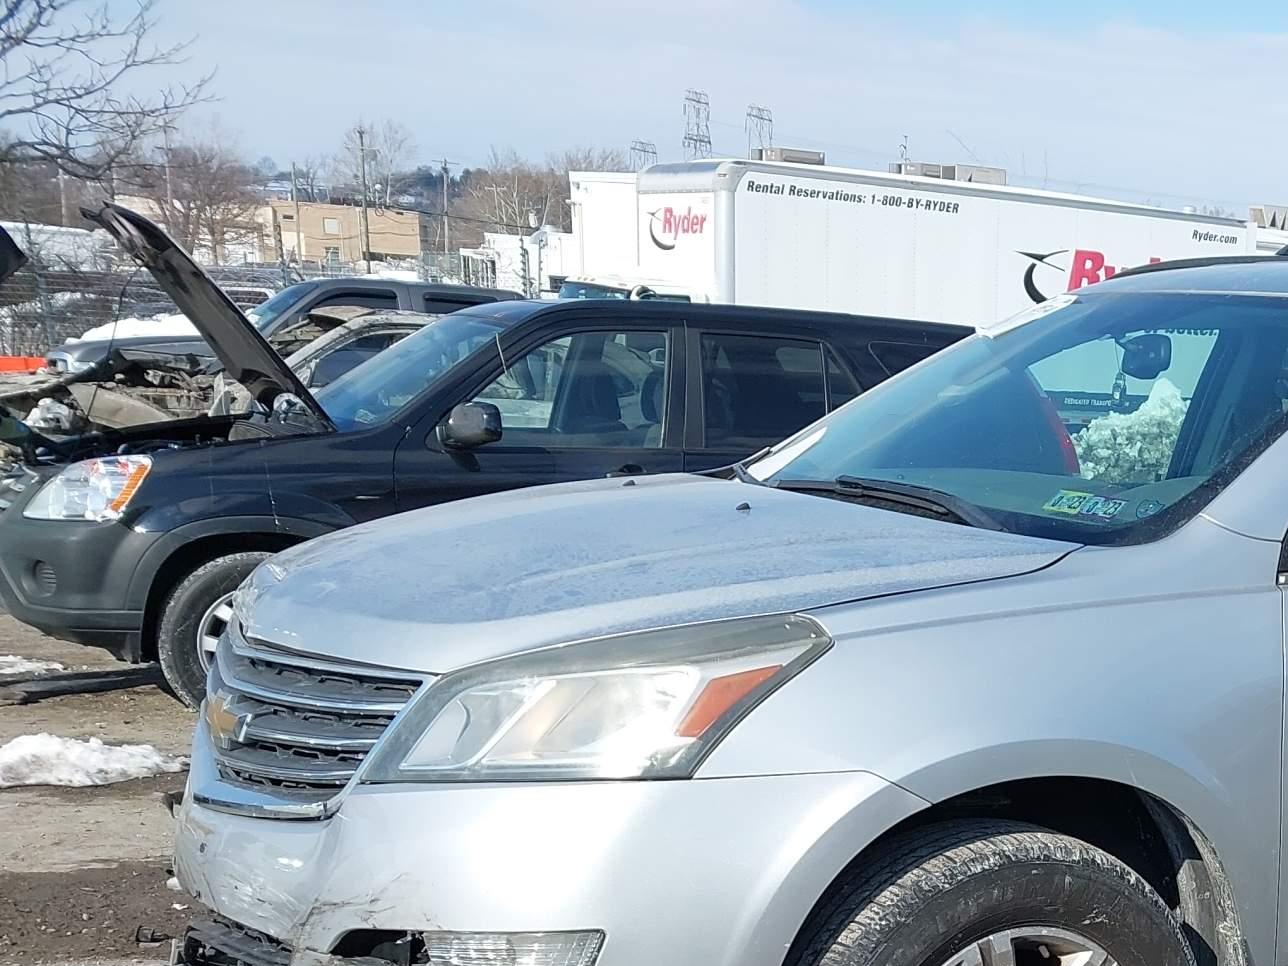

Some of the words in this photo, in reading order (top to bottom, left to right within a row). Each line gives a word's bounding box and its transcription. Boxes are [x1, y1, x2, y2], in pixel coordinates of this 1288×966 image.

[746, 180, 785, 195] Rental
[788, 184, 867, 204] Reservations:
[870, 194, 960, 214] 1-800-BY-RYDER
[662, 206, 707, 240] Ryder
[1191, 229, 1238, 245] Ryder.com
